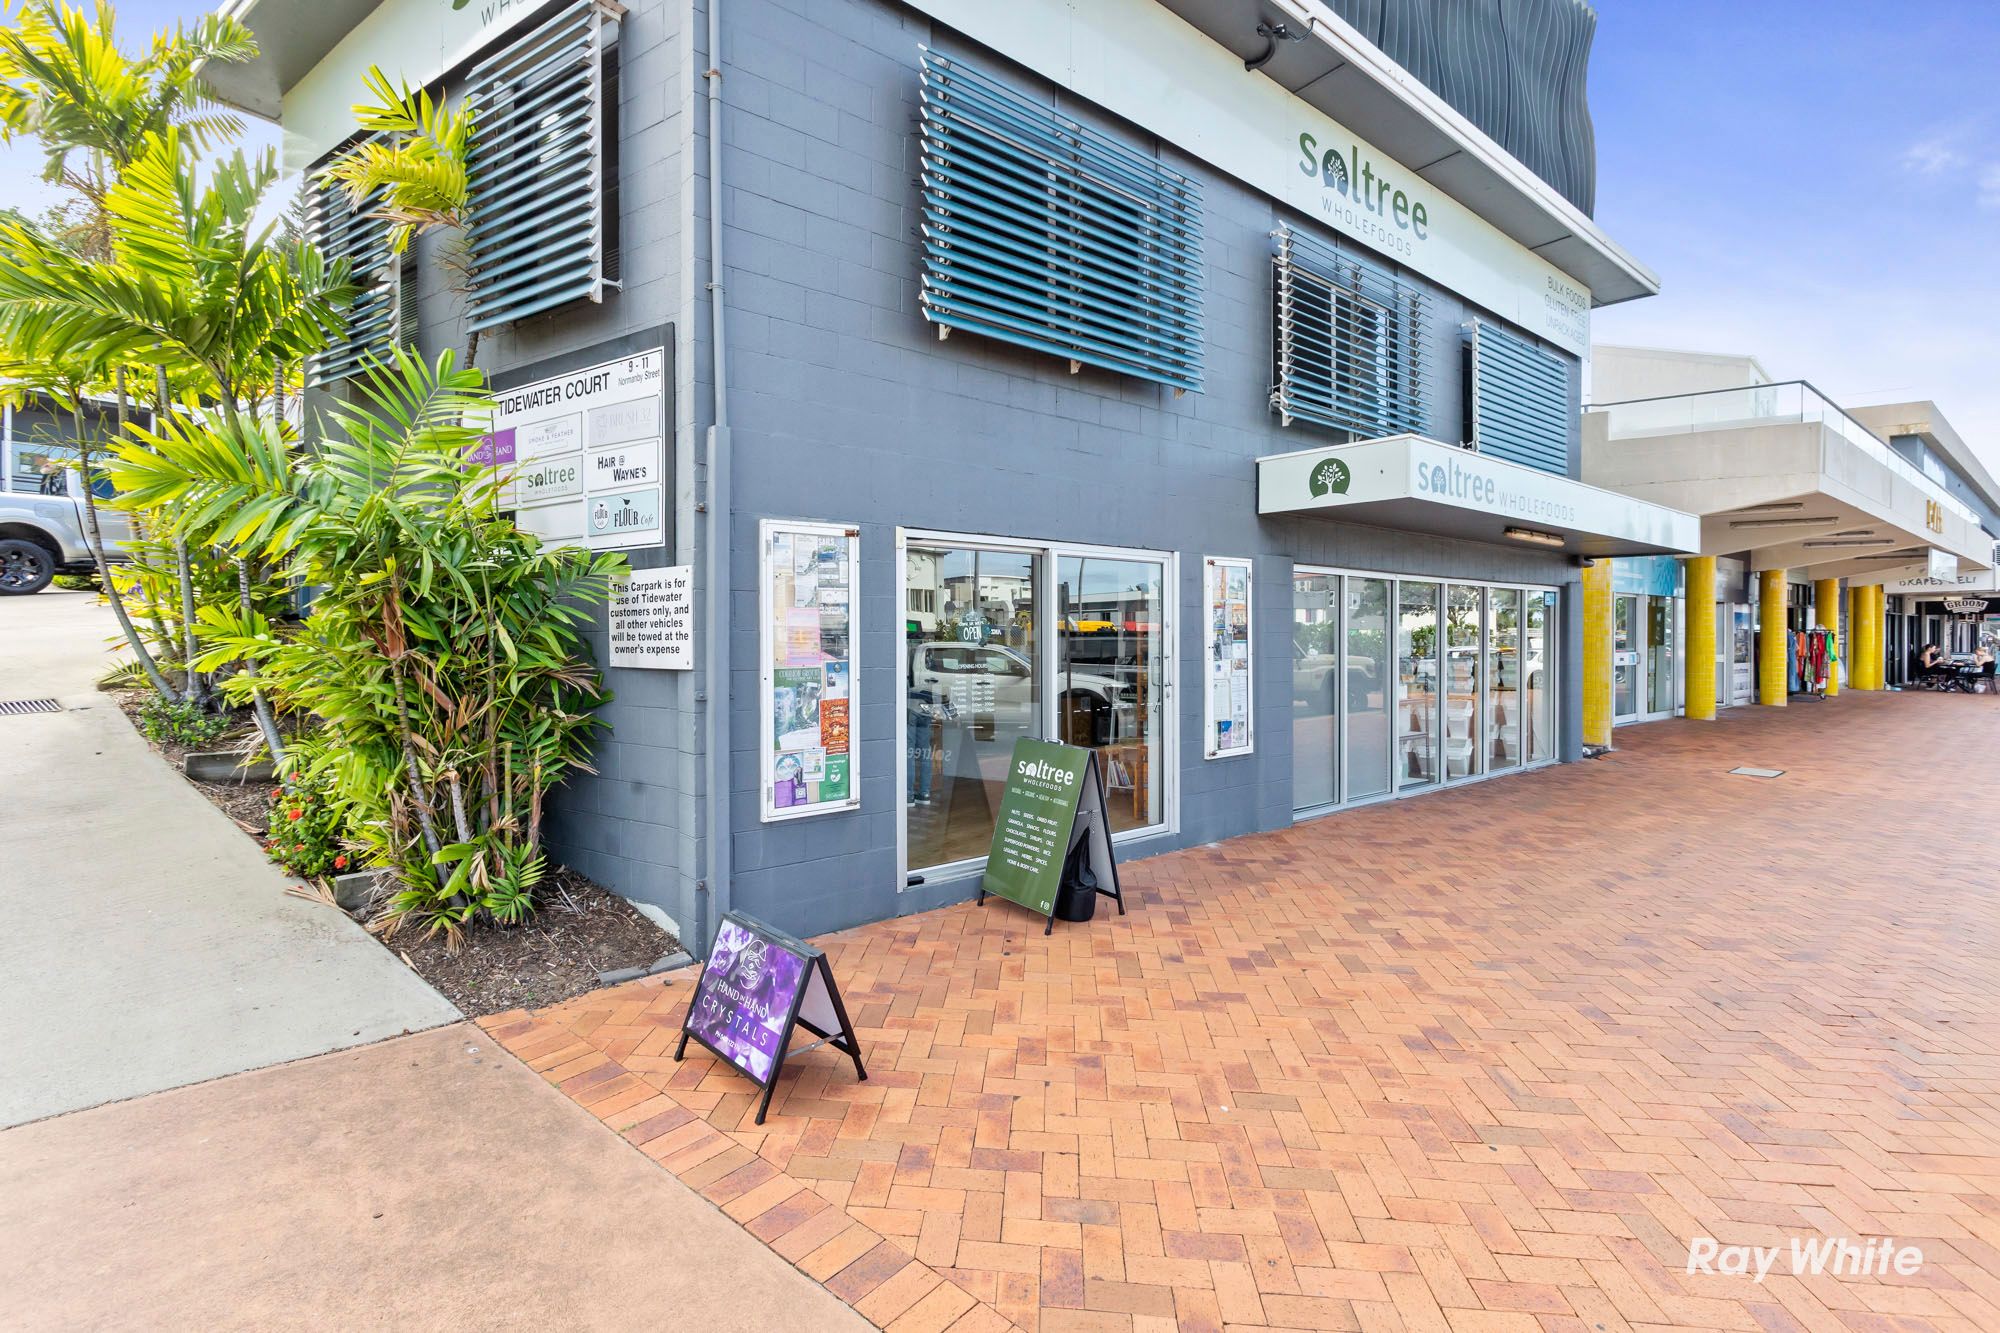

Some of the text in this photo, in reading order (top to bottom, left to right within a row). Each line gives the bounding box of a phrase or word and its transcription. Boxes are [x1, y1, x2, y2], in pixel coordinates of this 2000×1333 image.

[1298, 132, 1428, 240] saltree
[1321, 196, 1412, 257] WHOLEFOODS
[1548, 275, 1586, 310] BULK FOODS
[628, 361, 633, 372] 9
[642, 357, 648, 369] 11
[618, 369, 660, 386] Normanby Street
[498, 372, 610, 416] TIDEWATER COURT
[528, 434, 545, 443] SMOKE
[551, 429, 573, 439] FEATHER
[618, 455, 625, 466] @
[527, 467, 575, 488] saltree
[1418, 457, 1494, 505] saltree
[534, 485, 568, 495] WHOLEFOODS
[1499, 492, 1575, 521] WHOLEFOODS
[614, 507, 639, 527] FLOUR
[612, 578, 686, 593] This Carpark is for
[616, 592, 682, 605] use of Tidewater
[1947, 600, 1985, 609] GROOM
[610, 604, 689, 617] customers only, and
[615, 618, 683, 629] all other vehicles
[611, 631, 689, 641] will be towed at the
[963, 626, 982, 640] OPEN
[614, 644, 680, 656] owner's expense
[1017, 759, 1073, 785] saltree
[1023, 777, 1062, 791] WHOLEFOODS
[717, 979, 740, 1001] HAND
[743, 996, 767, 1018] HAND
[702, 995, 768, 1046] CRYSTALS
